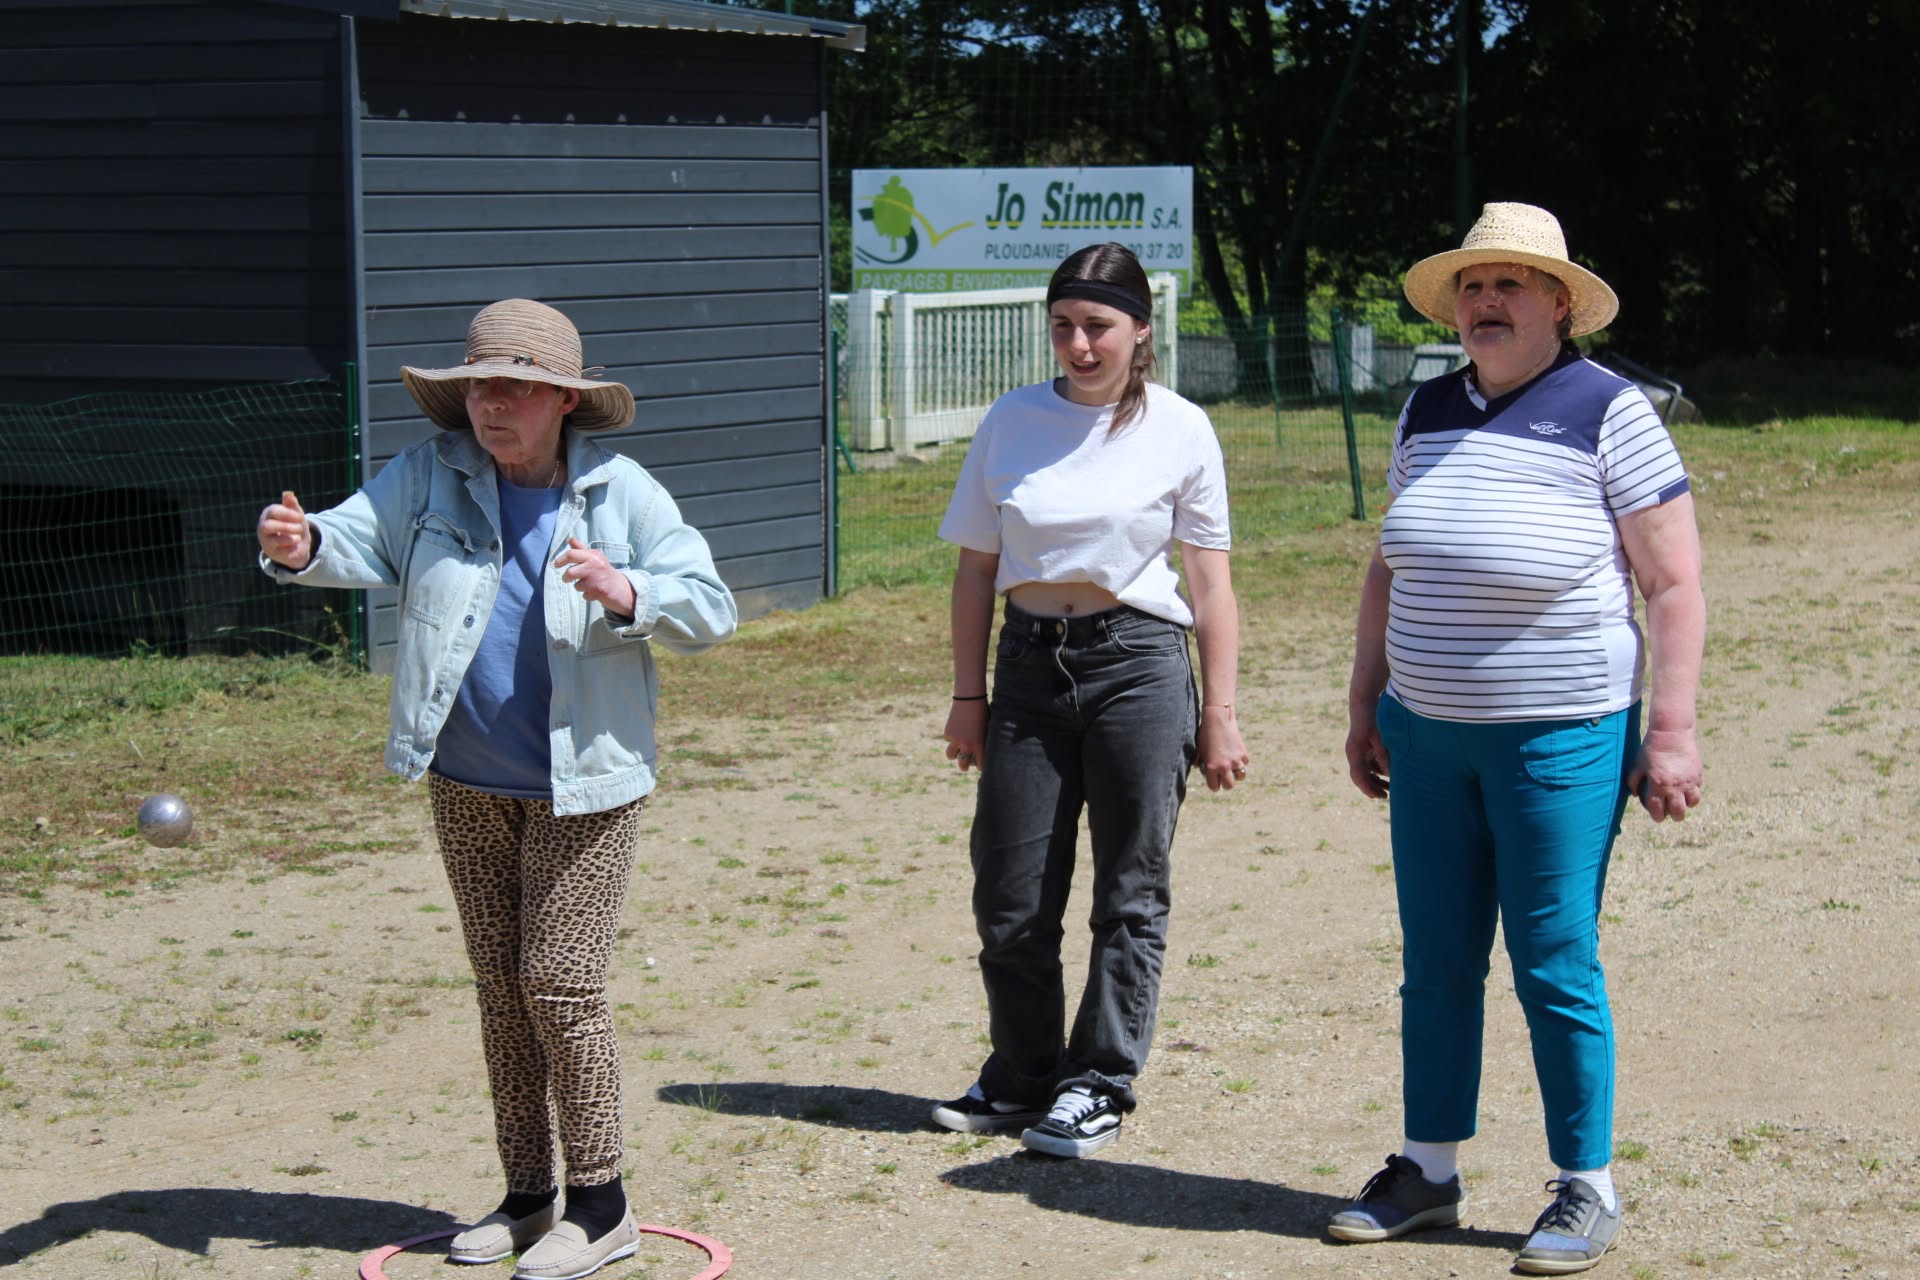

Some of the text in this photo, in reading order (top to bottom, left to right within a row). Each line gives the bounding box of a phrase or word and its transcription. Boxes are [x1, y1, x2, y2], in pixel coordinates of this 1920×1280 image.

[986, 181, 1183, 230] Jo Simon S.A.
[1146, 243, 1163, 259] 37
[1167, 243, 1184, 259] 20
[861, 273, 1050, 290] PAYSAGES ENVIRONNE
